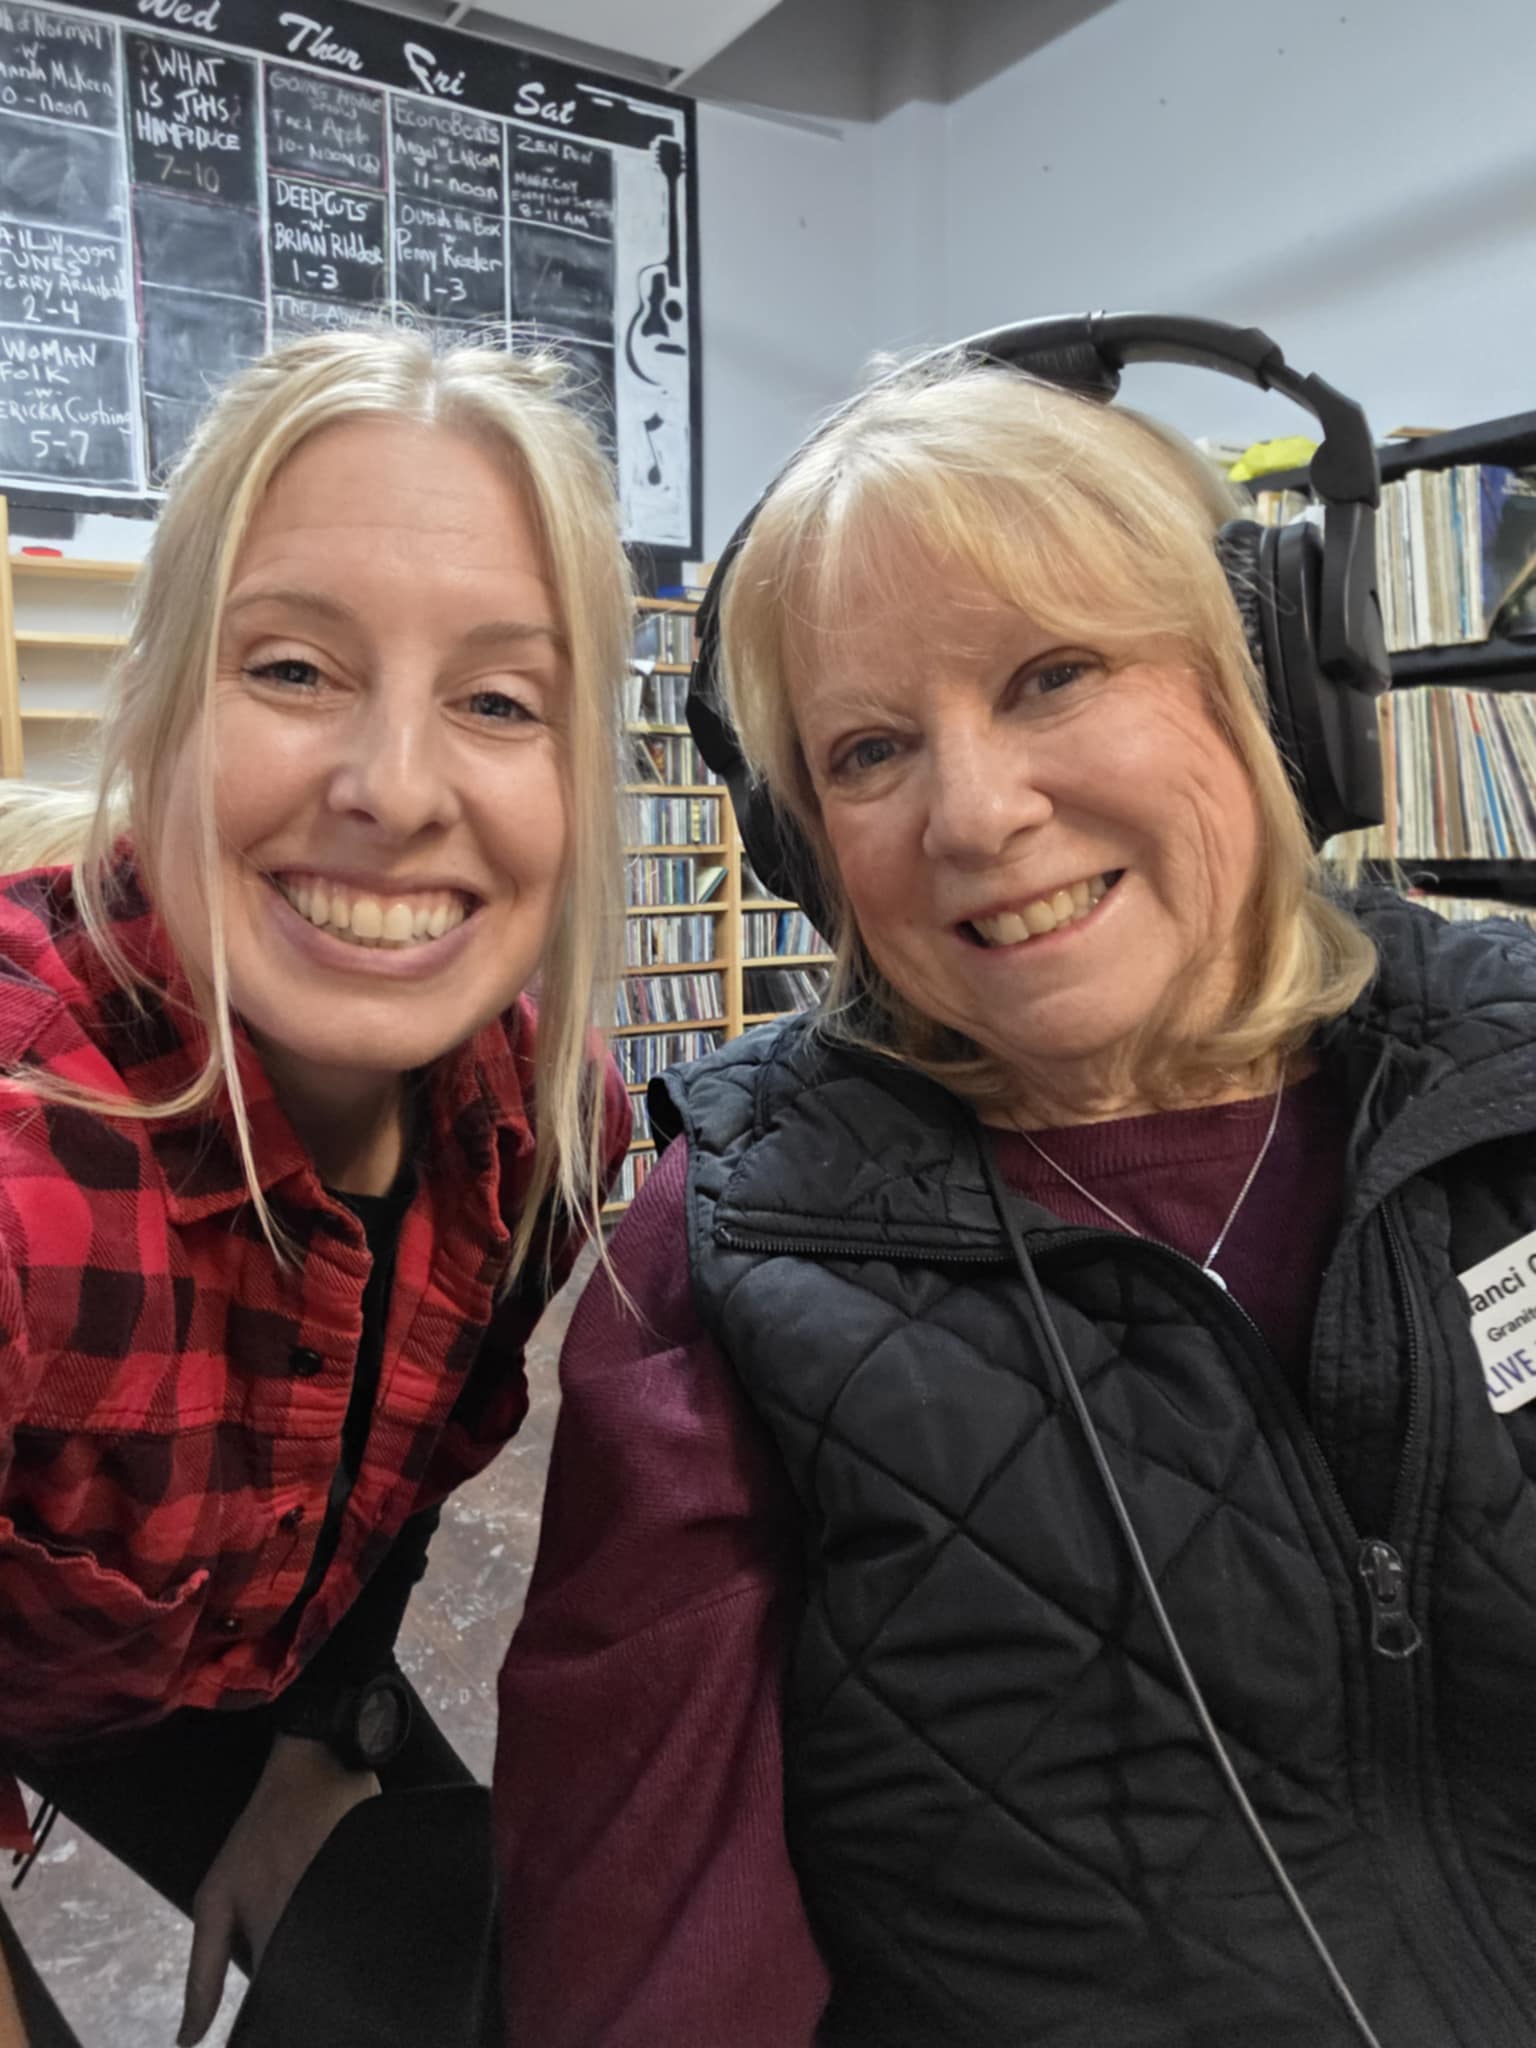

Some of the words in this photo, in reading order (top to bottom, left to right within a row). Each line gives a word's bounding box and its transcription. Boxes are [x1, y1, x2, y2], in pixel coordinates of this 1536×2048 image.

[279, 12, 363, 71] Thur
[403, 43, 466, 95] Fri
[140, 78, 164, 109] IS
[514, 82, 578, 125] Sat
[273, 221, 327, 257] BRIAN
